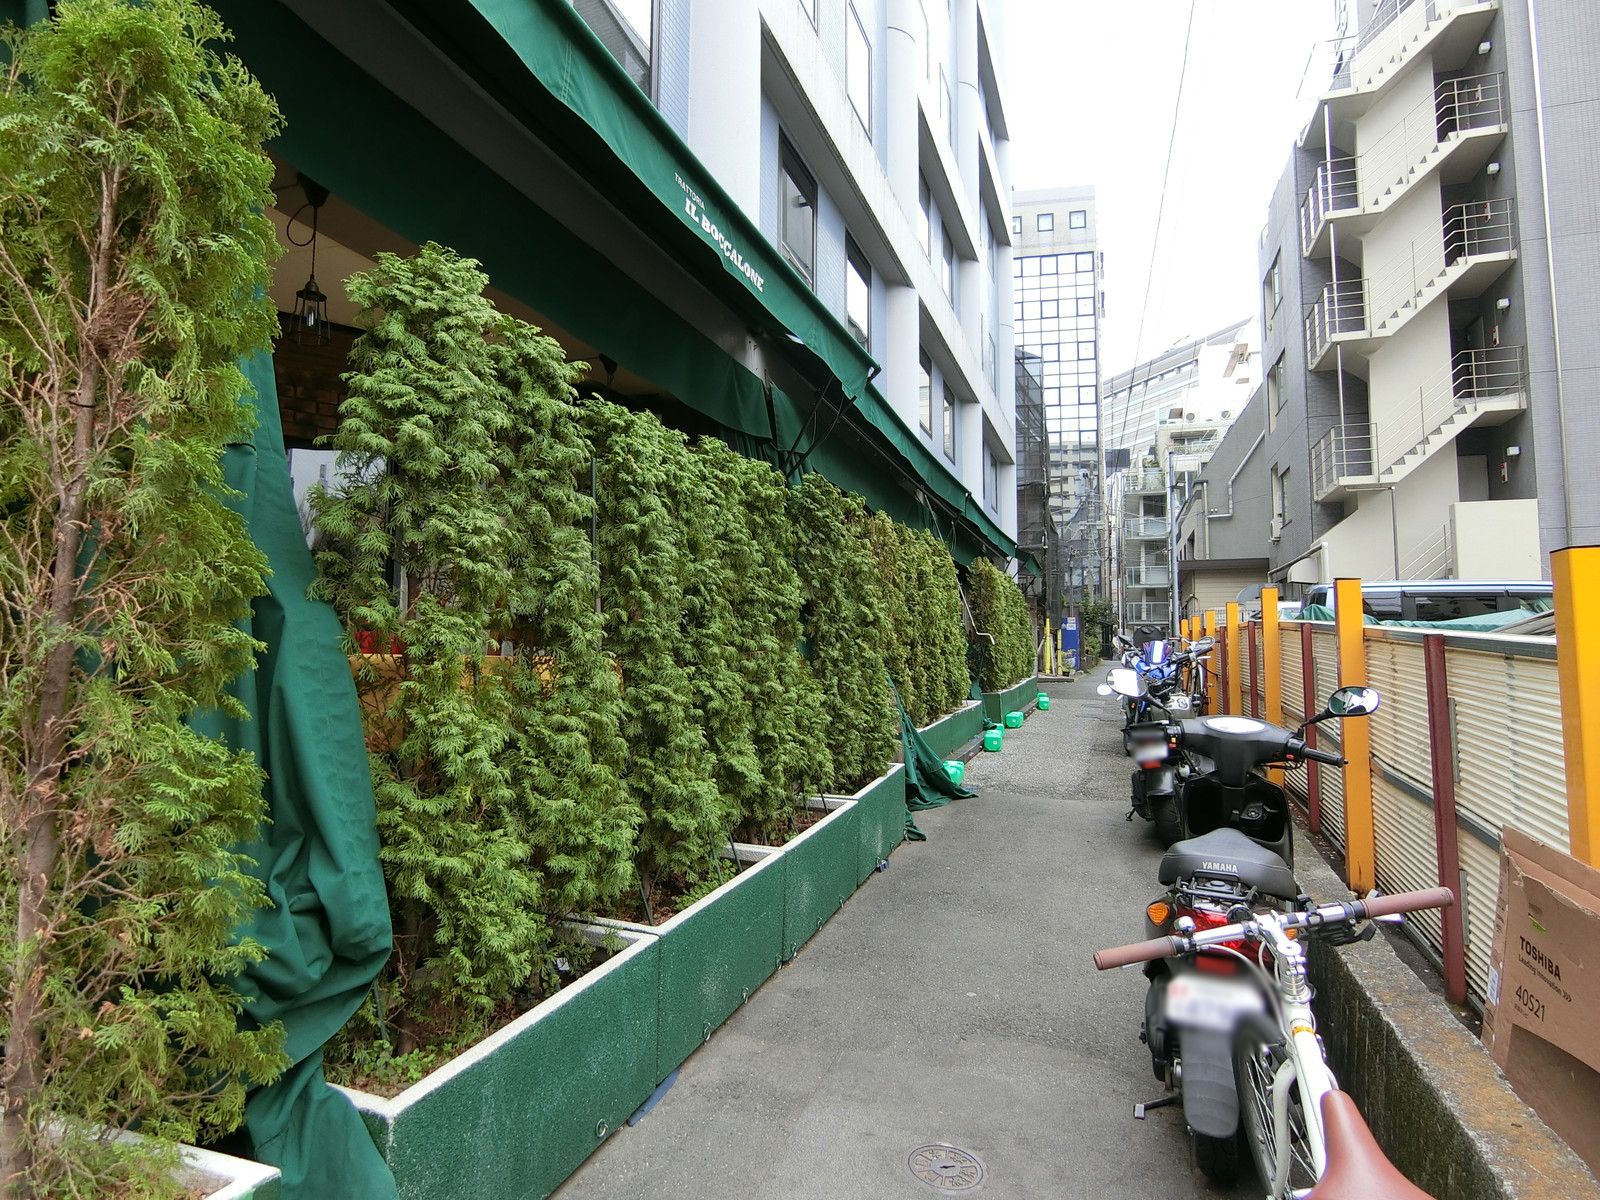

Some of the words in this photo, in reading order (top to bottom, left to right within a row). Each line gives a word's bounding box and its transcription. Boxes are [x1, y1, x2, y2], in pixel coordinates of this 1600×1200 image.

[675, 172, 706, 211] TRATTORIA
[685, 197, 700, 224] IL
[701, 213, 764, 292] BOCCALONE
[1202, 861, 1238, 873] YAMAHA
[1519, 935, 1562, 982] TOSHIBA
[1515, 985, 1545, 1022] 40S21
